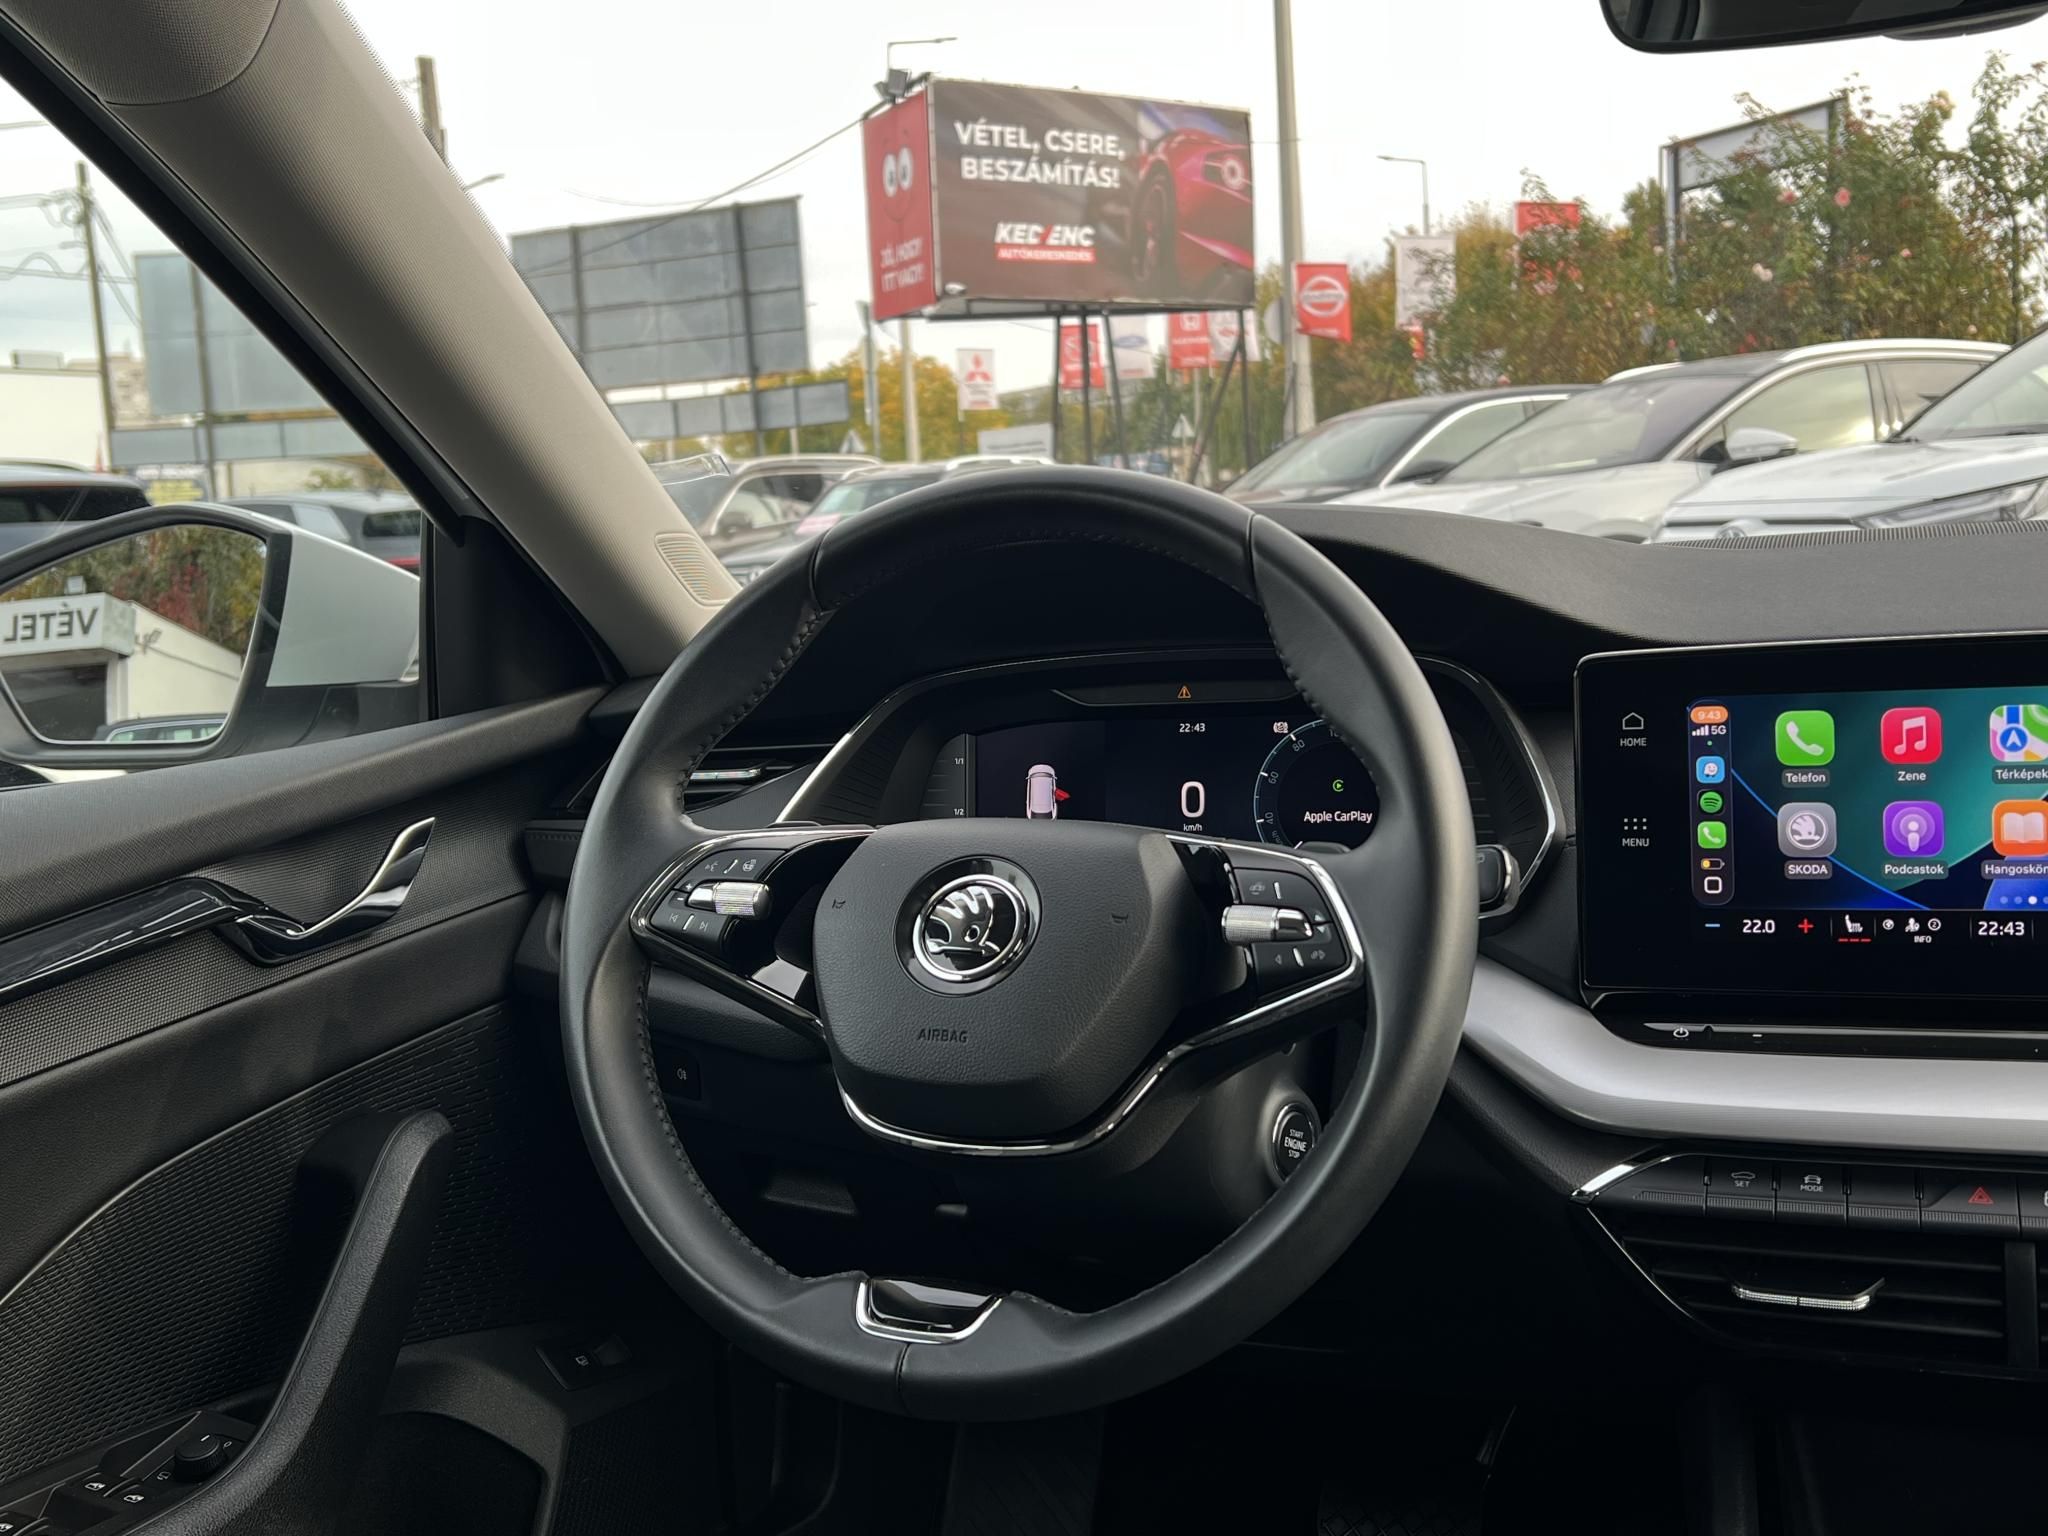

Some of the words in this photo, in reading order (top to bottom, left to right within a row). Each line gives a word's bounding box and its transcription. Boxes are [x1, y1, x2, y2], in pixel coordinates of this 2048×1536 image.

[954, 117, 1040, 153] VÉTEL,
[1044, 130, 1126, 161] CSERE,
[960, 156, 1121, 188] BESZÁMÍTÁS!
[1179, 723, 1206, 732] 22:43
[1710, 725, 1727, 735] 5G
[1292, 739, 1306, 752] 80
[1620, 738, 1647, 747] HOME
[1268, 771, 1279, 784] 60
[1785, 773, 1826, 783] Telefon
[1897, 771, 1927, 781] Zene
[1995, 769, 2048, 780] Térképek
[1181, 781, 1205, 818] 0
[953, 808, 965, 816] 1/2
[1265, 811, 1274, 824] 40
[1303, 811, 1333, 823] Apple
[1334, 811, 1373, 823] CarPlay
[1183, 824, 1202, 832] km/h
[1622, 838, 1650, 847] MENU
[1788, 864, 1828, 875] SKODA
[1884, 864, 1944, 875] Podcastok
[1742, 919, 1776, 934] 22.0
[1978, 921, 2025, 936] 22:43
[1913, 935, 1932, 943] INFO
[917, 1028, 969, 1043] AIRBAG
[1289, 1129, 1304, 1139] START
[1284, 1136, 1307, 1152] ENGINE
[1288, 1149, 1300, 1159] STOP
[1800, 1184, 1824, 1192] MODE
